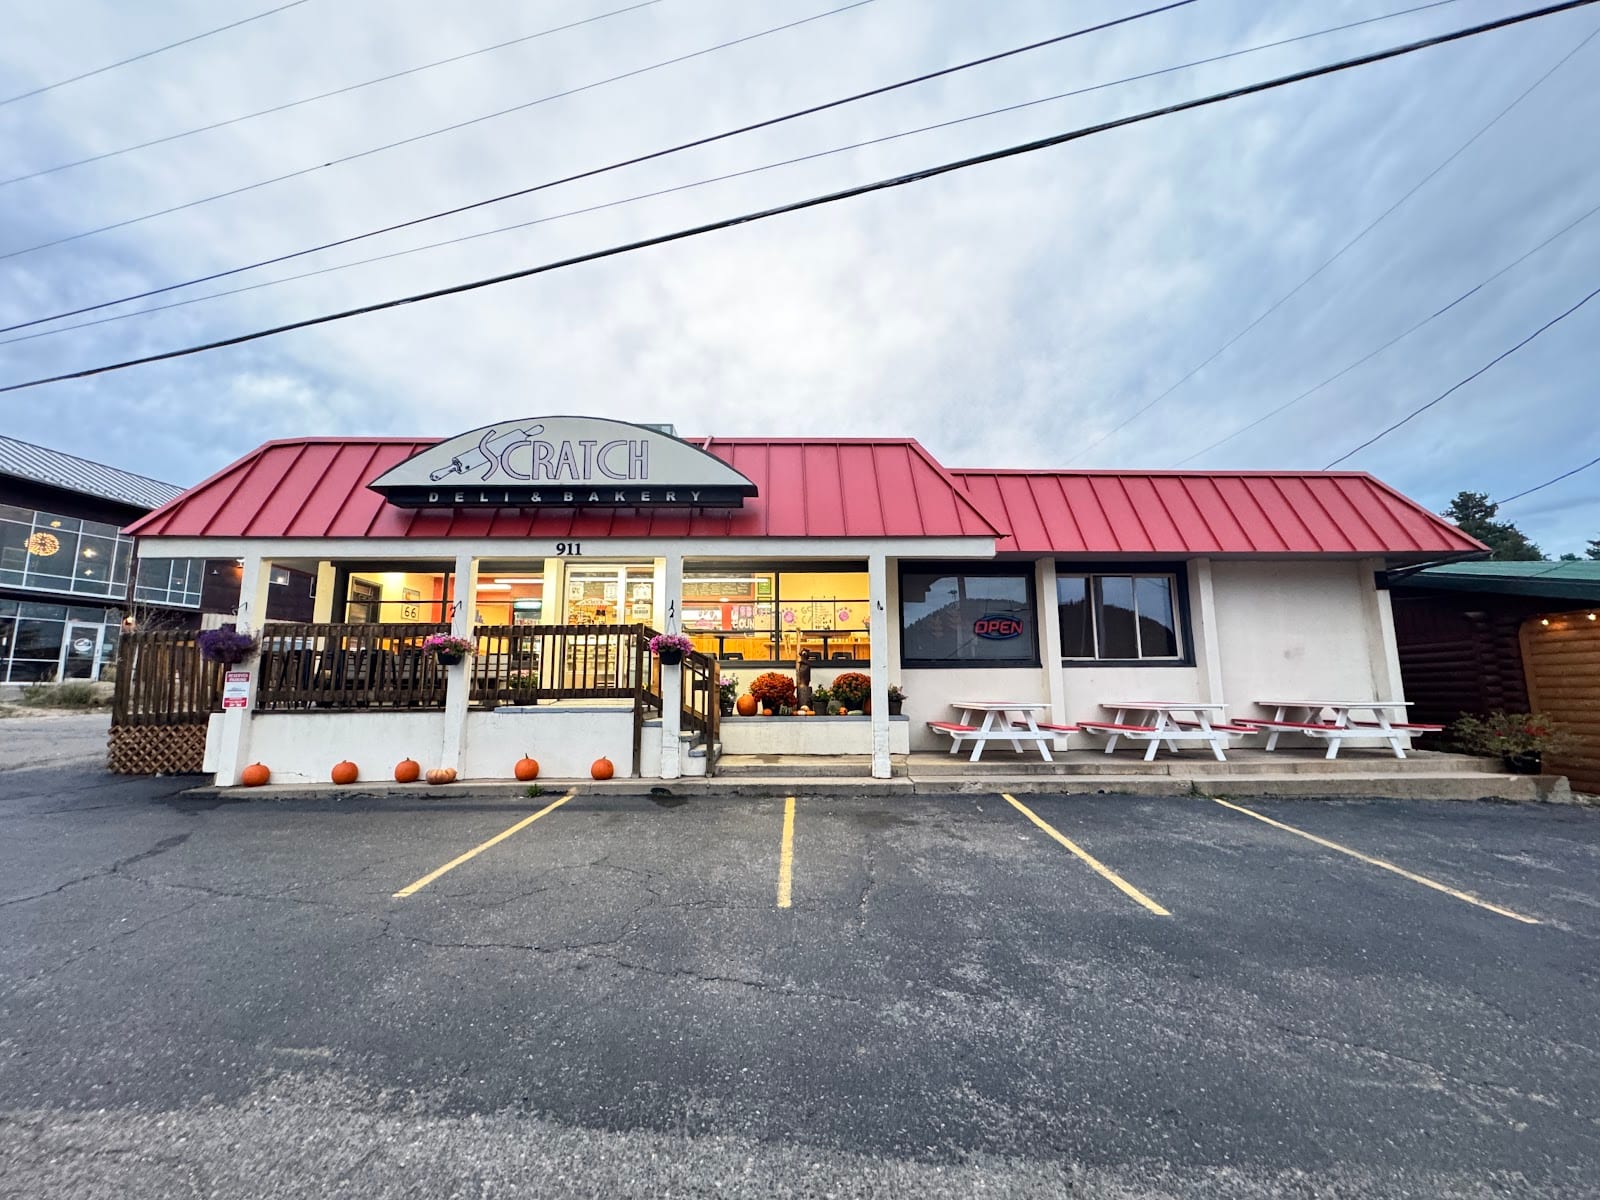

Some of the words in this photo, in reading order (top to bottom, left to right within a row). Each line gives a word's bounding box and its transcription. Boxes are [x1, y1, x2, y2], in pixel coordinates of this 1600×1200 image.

[479, 429, 649, 482] SCRATCH
[428, 491, 510, 503] DELI
[531, 491, 542, 503] &
[563, 491, 702, 503] BAKERY
[555, 543, 583, 556] 911
[405, 606, 416, 618] 66
[974, 619, 1023, 635] OPEN
